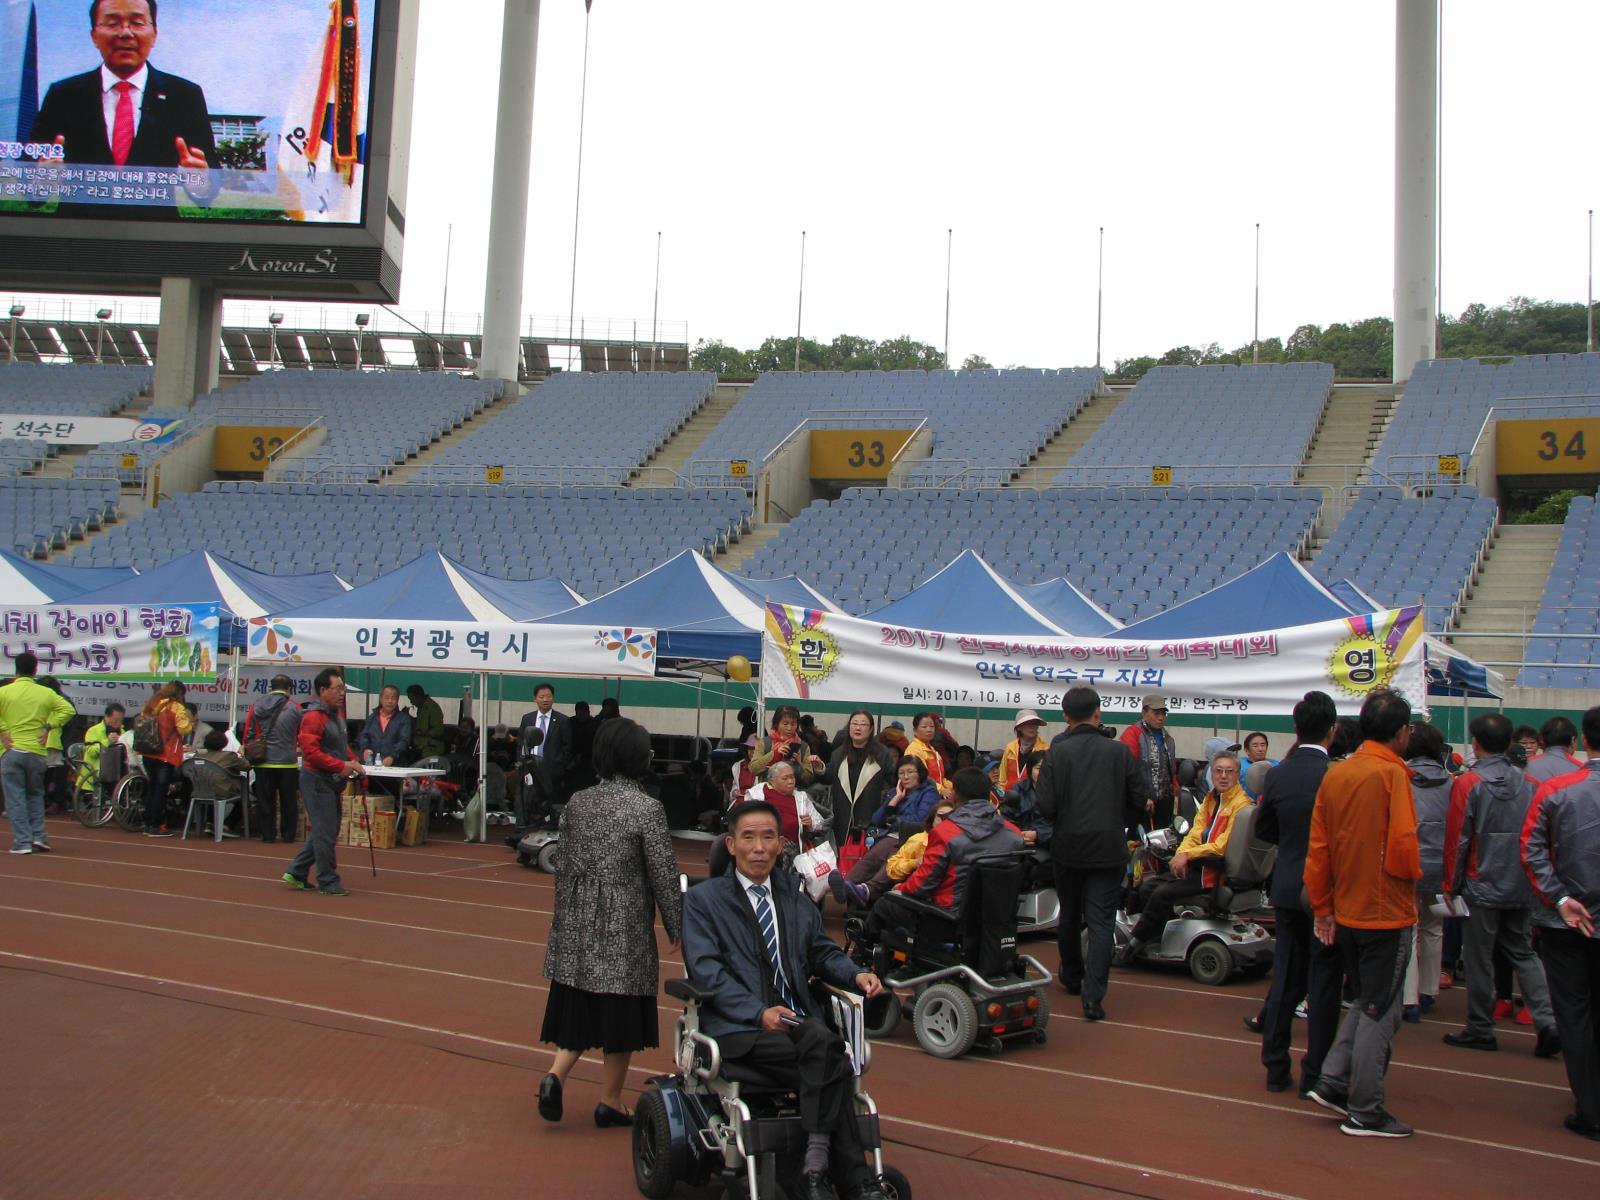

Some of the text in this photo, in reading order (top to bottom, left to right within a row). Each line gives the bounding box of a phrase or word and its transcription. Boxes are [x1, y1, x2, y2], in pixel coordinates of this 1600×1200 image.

[87, 169, 119, 182] 담장에
[121, 170, 143, 184] 대해
[87, 185, 109, 198] 라고
[13, 421, 76, 438] 선수단
[250, 436, 285, 462] 32
[848, 440, 885, 468] 33
[1537, 430, 1587, 461] 34
[48, 608, 130, 639] 장애인
[140, 607, 192, 640] 협회
[356, 627, 529, 662] 인천광역시
[880, 626, 945, 650] 2017
[798, 638, 827, 670] 환
[1344, 648, 1377, 684] 영
[976, 661, 1022, 680] 인천
[1032, 665, 1105, 686] 연수구
[902, 686, 931, 701] 일시:
[936, 689, 973, 702] 2017.
[980, 691, 999, 703] 10.
[1006, 692, 1021, 703] 18
